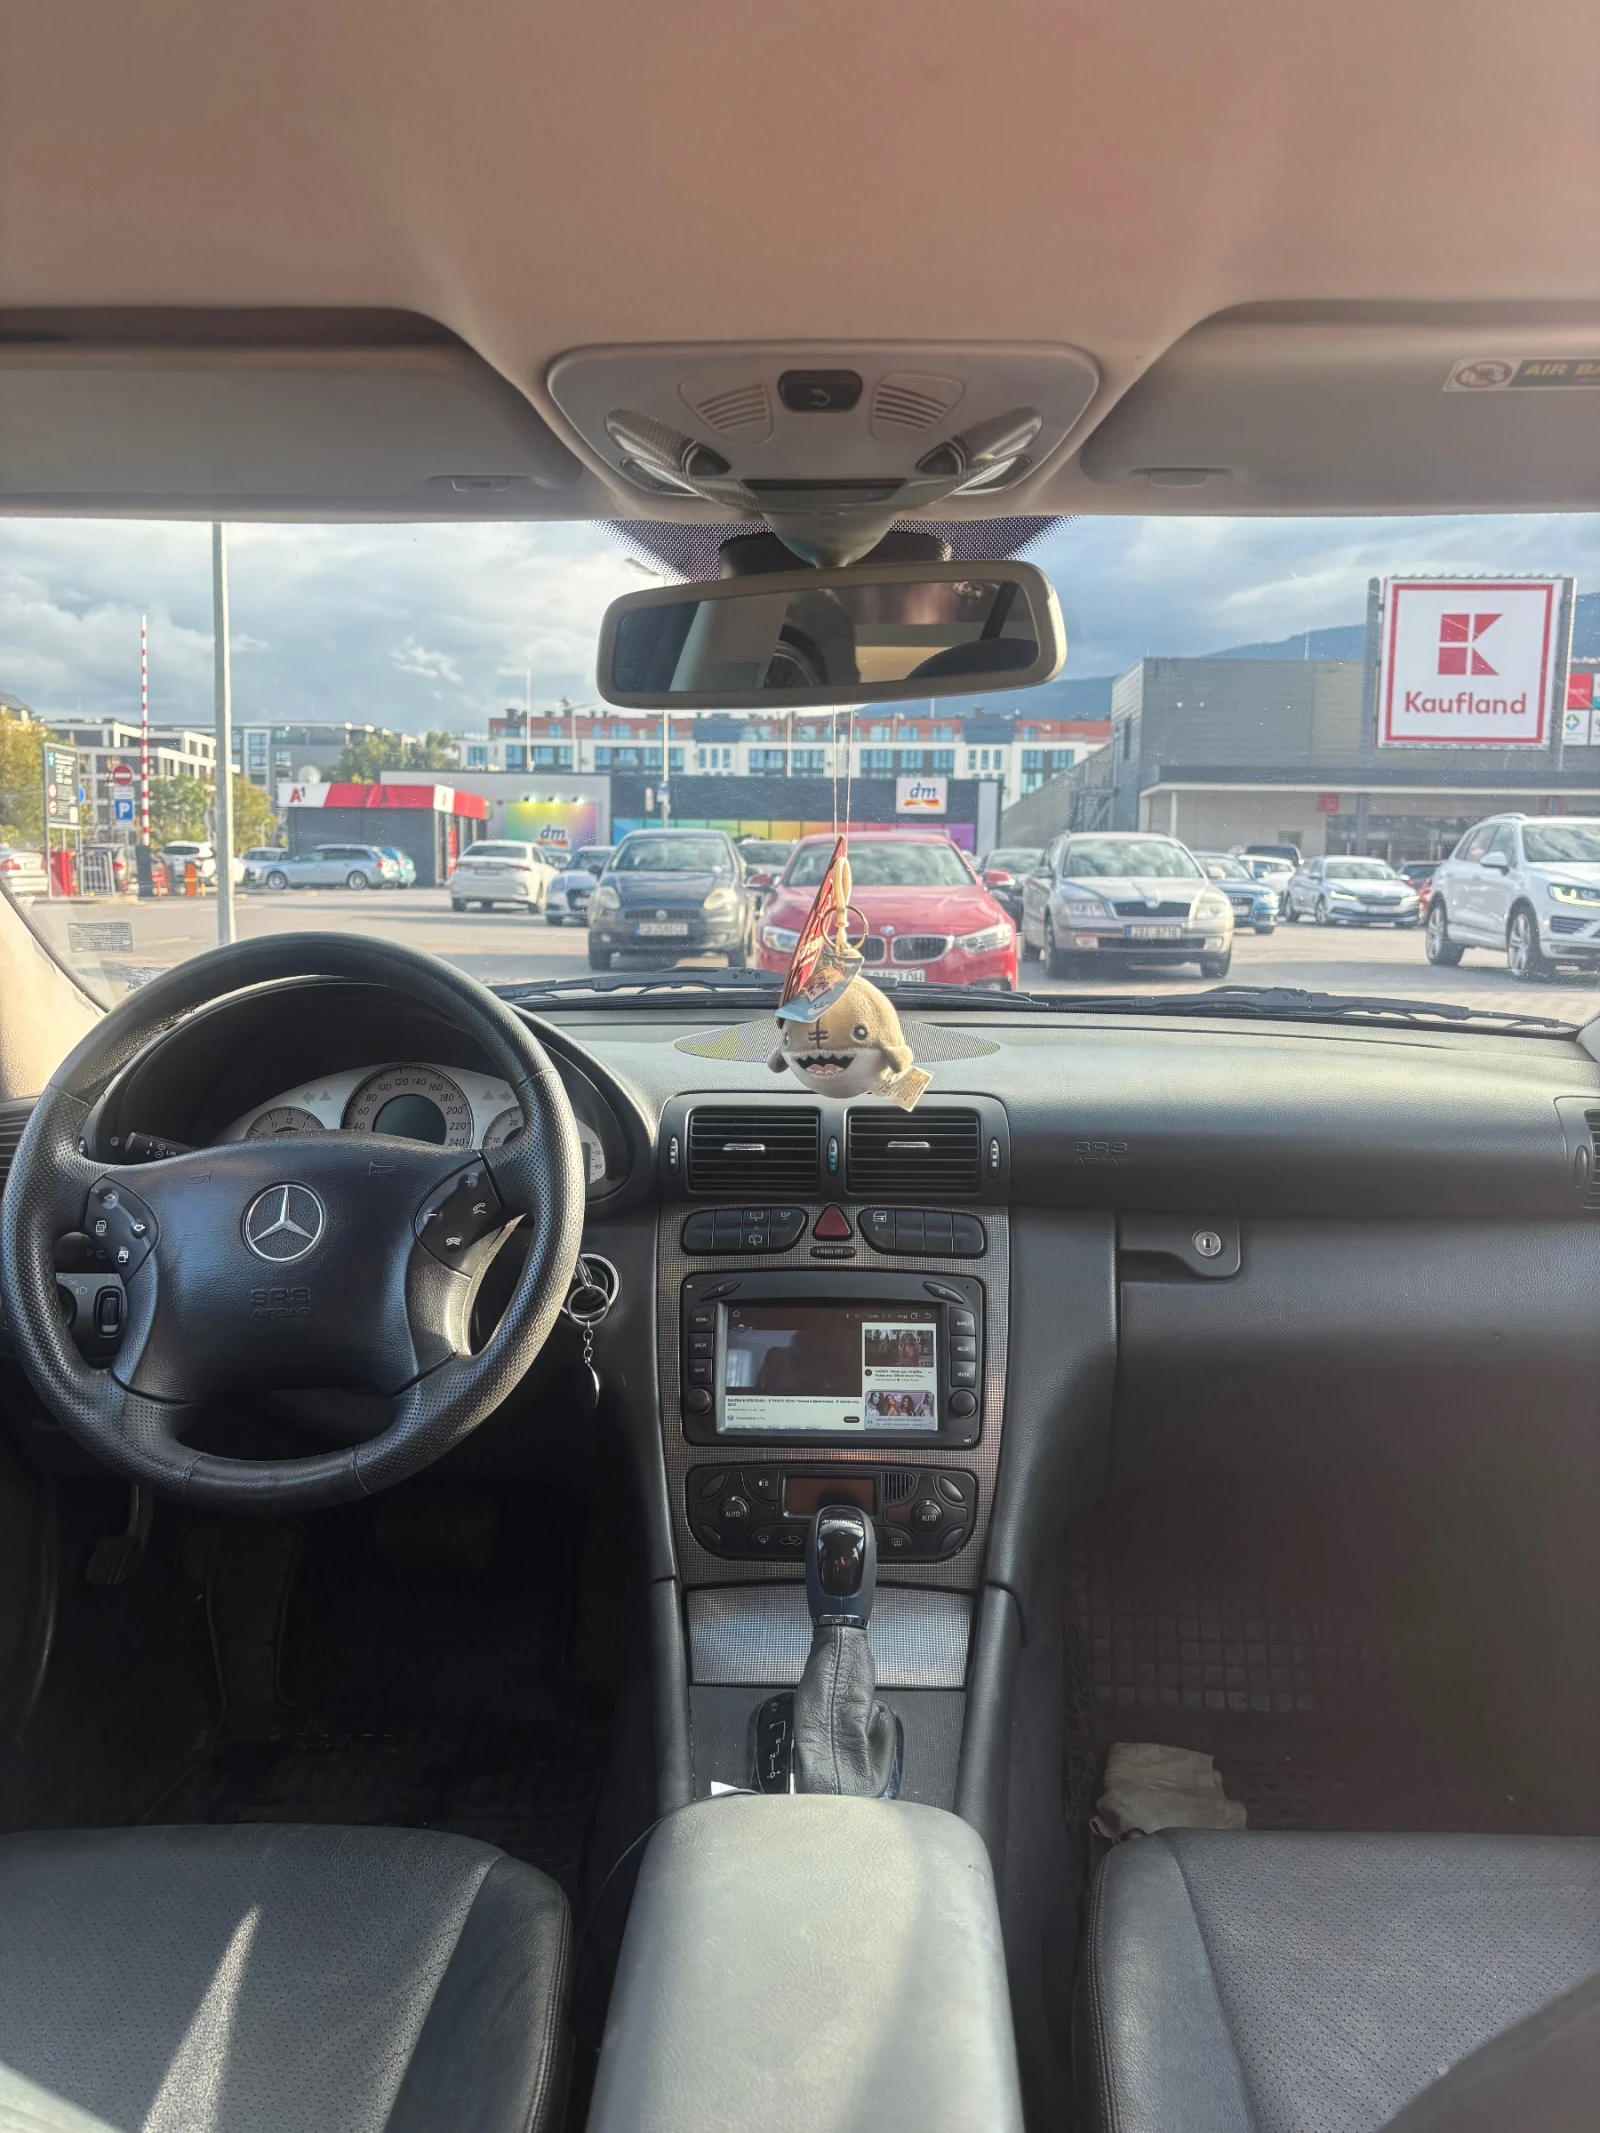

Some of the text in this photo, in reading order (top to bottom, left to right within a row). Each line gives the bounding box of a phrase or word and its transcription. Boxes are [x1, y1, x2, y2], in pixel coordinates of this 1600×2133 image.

[1404, 691, 1527, 715] Kaufland
[289, 786, 306, 803] A1
[909, 782, 936, 799] dm
[118, 802, 131, 819] P
[541, 824, 566, 840] dm
[394, 1078, 409, 1086] 120
[411, 1077, 427, 1086] 140
[378, 1083, 392, 1092] 100
[428, 1083, 443, 1092] 160
[365, 1094, 378, 1102] 80
[440, 1093, 455, 1102] 180
[357, 1107, 370, 1115] 60
[445, 1106, 463, 1115] 200
[353, 1122, 365, 1131] 40
[449, 1122, 467, 1131] 220
[448, 1138, 465, 1147] 240
[921, 1514, 937, 1522] AUTO
